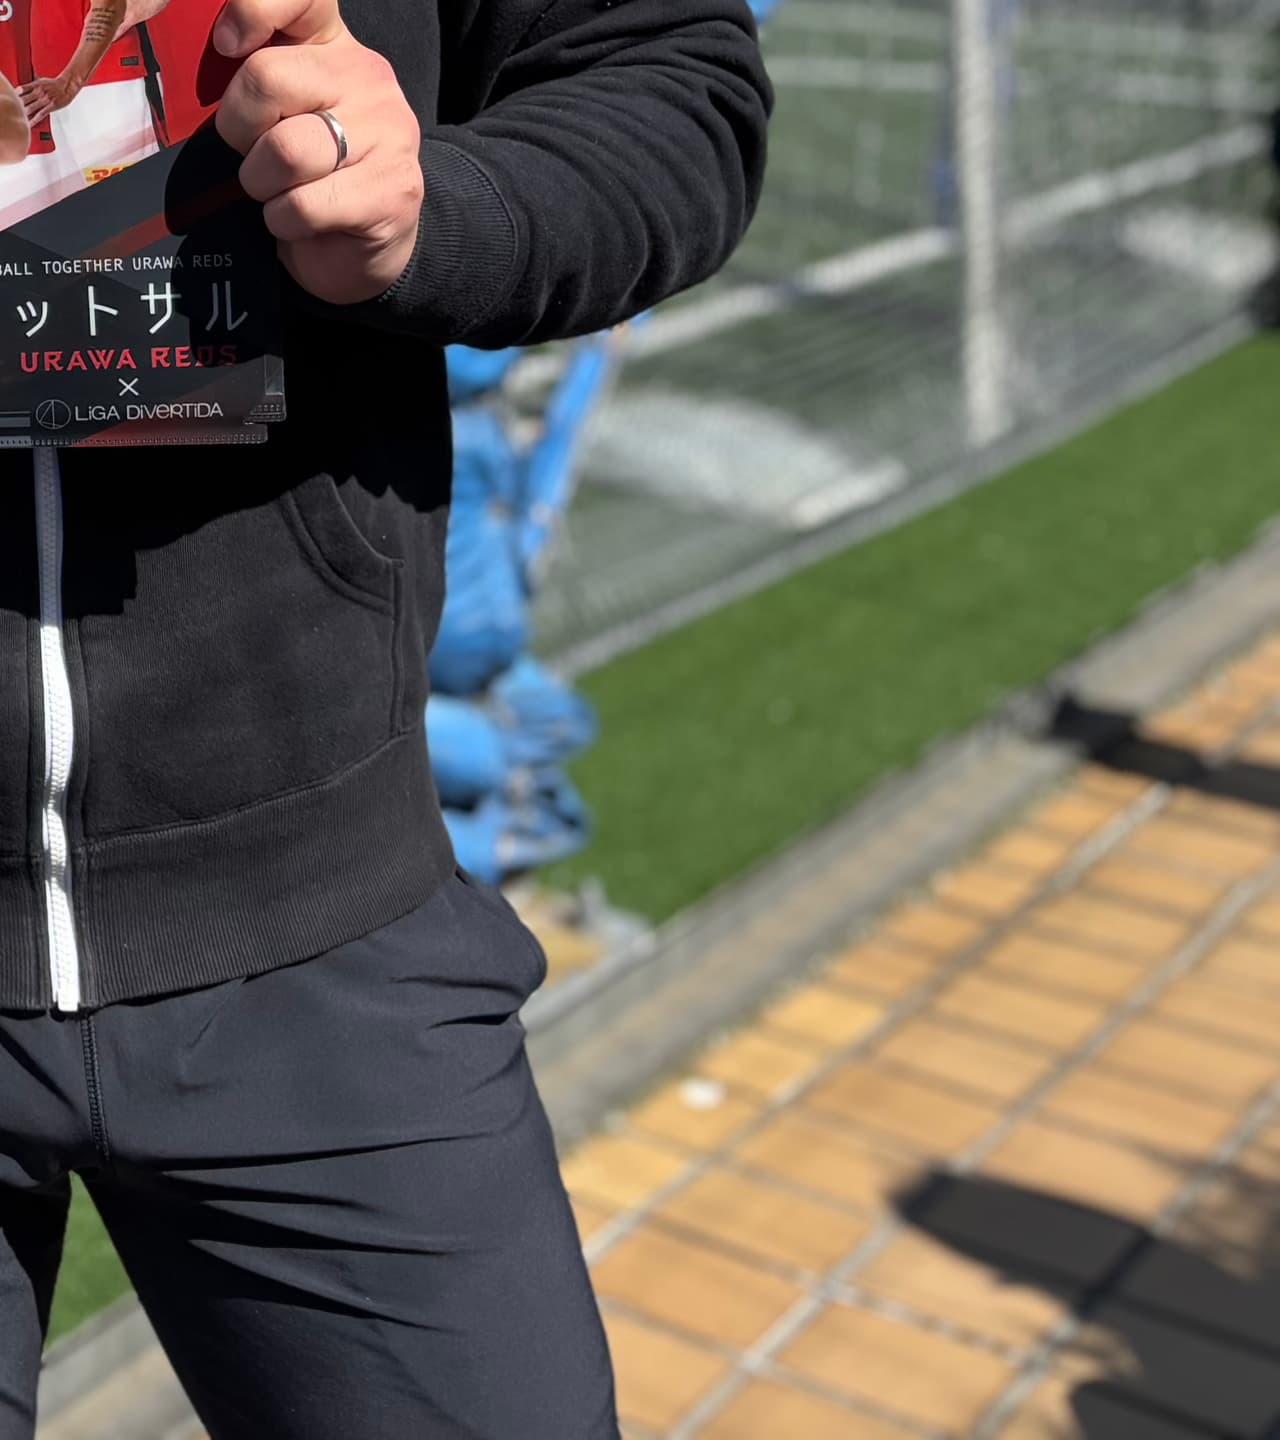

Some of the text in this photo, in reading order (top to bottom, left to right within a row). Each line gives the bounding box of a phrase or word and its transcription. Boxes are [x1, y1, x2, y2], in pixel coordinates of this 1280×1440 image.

[42, 259, 124, 274] TOGETHER
[132, 256, 183, 271] URAWA
[193, 254, 233, 268] REDS
[20, 348, 136, 373] URAWA
